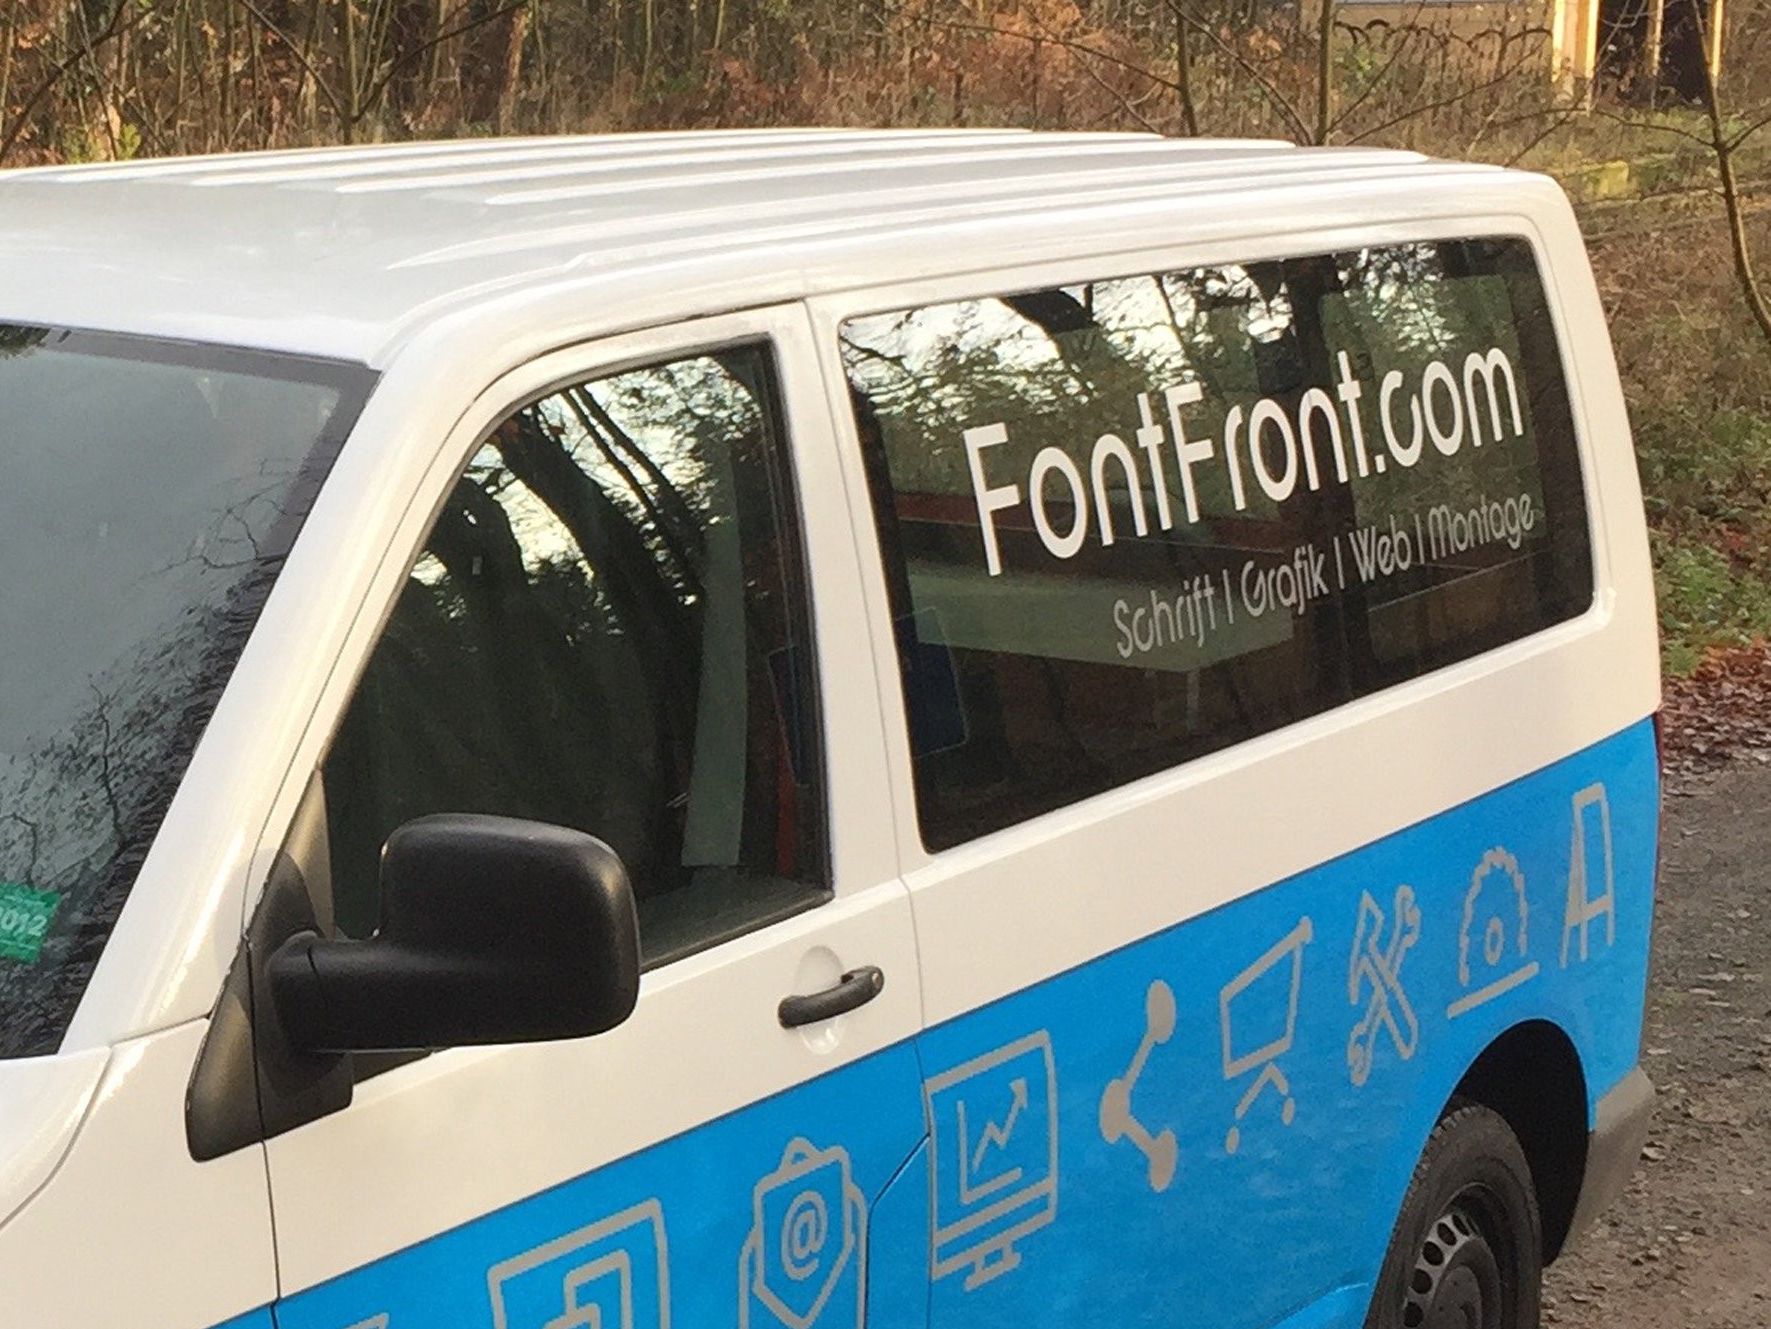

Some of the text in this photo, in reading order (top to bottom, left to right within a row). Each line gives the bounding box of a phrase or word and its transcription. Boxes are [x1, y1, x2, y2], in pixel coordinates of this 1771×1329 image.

[963, 346, 1524, 576] FontFront.com
[1113, 567, 1218, 659] Schrift
[1241, 544, 1330, 617] Grafik
[1349, 514, 1412, 581] Web
[1429, 492, 1535, 561] Montage
